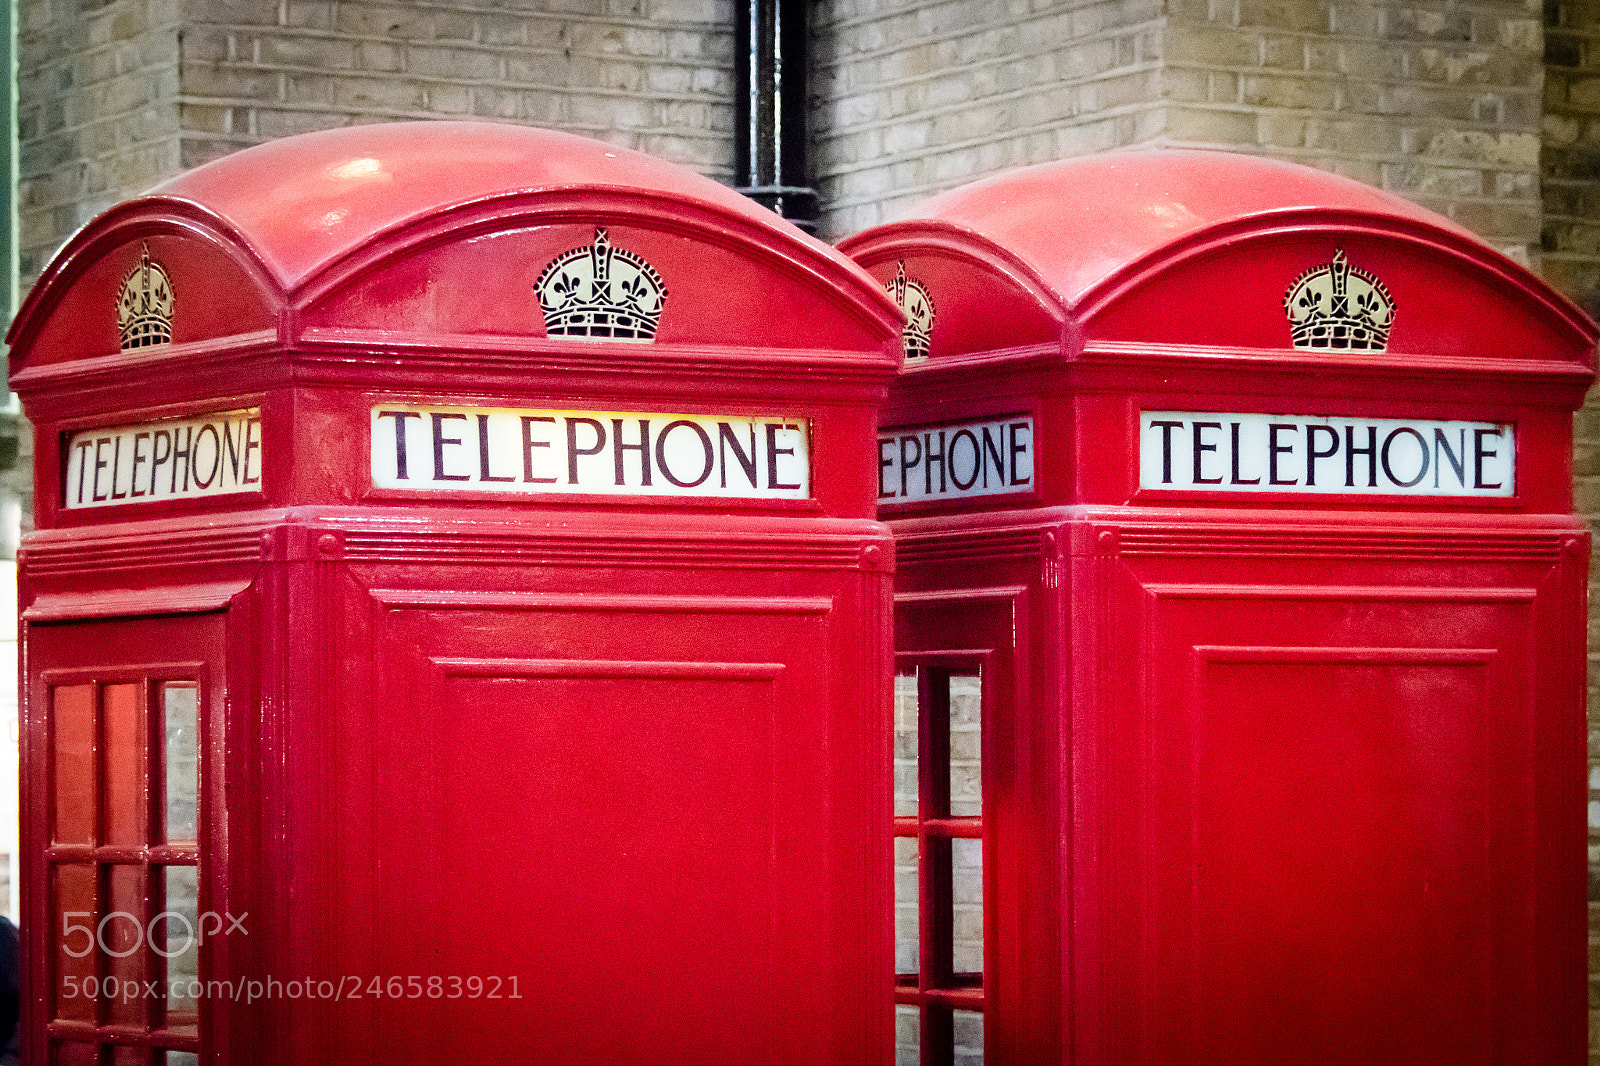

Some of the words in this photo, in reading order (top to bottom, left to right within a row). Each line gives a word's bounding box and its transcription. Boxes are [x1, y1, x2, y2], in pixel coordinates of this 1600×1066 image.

[76, 416, 260, 503] TELEPHONE
[379, 410, 803, 490] TELEPHONE
[1150, 420, 1502, 490] TELEPHONE
